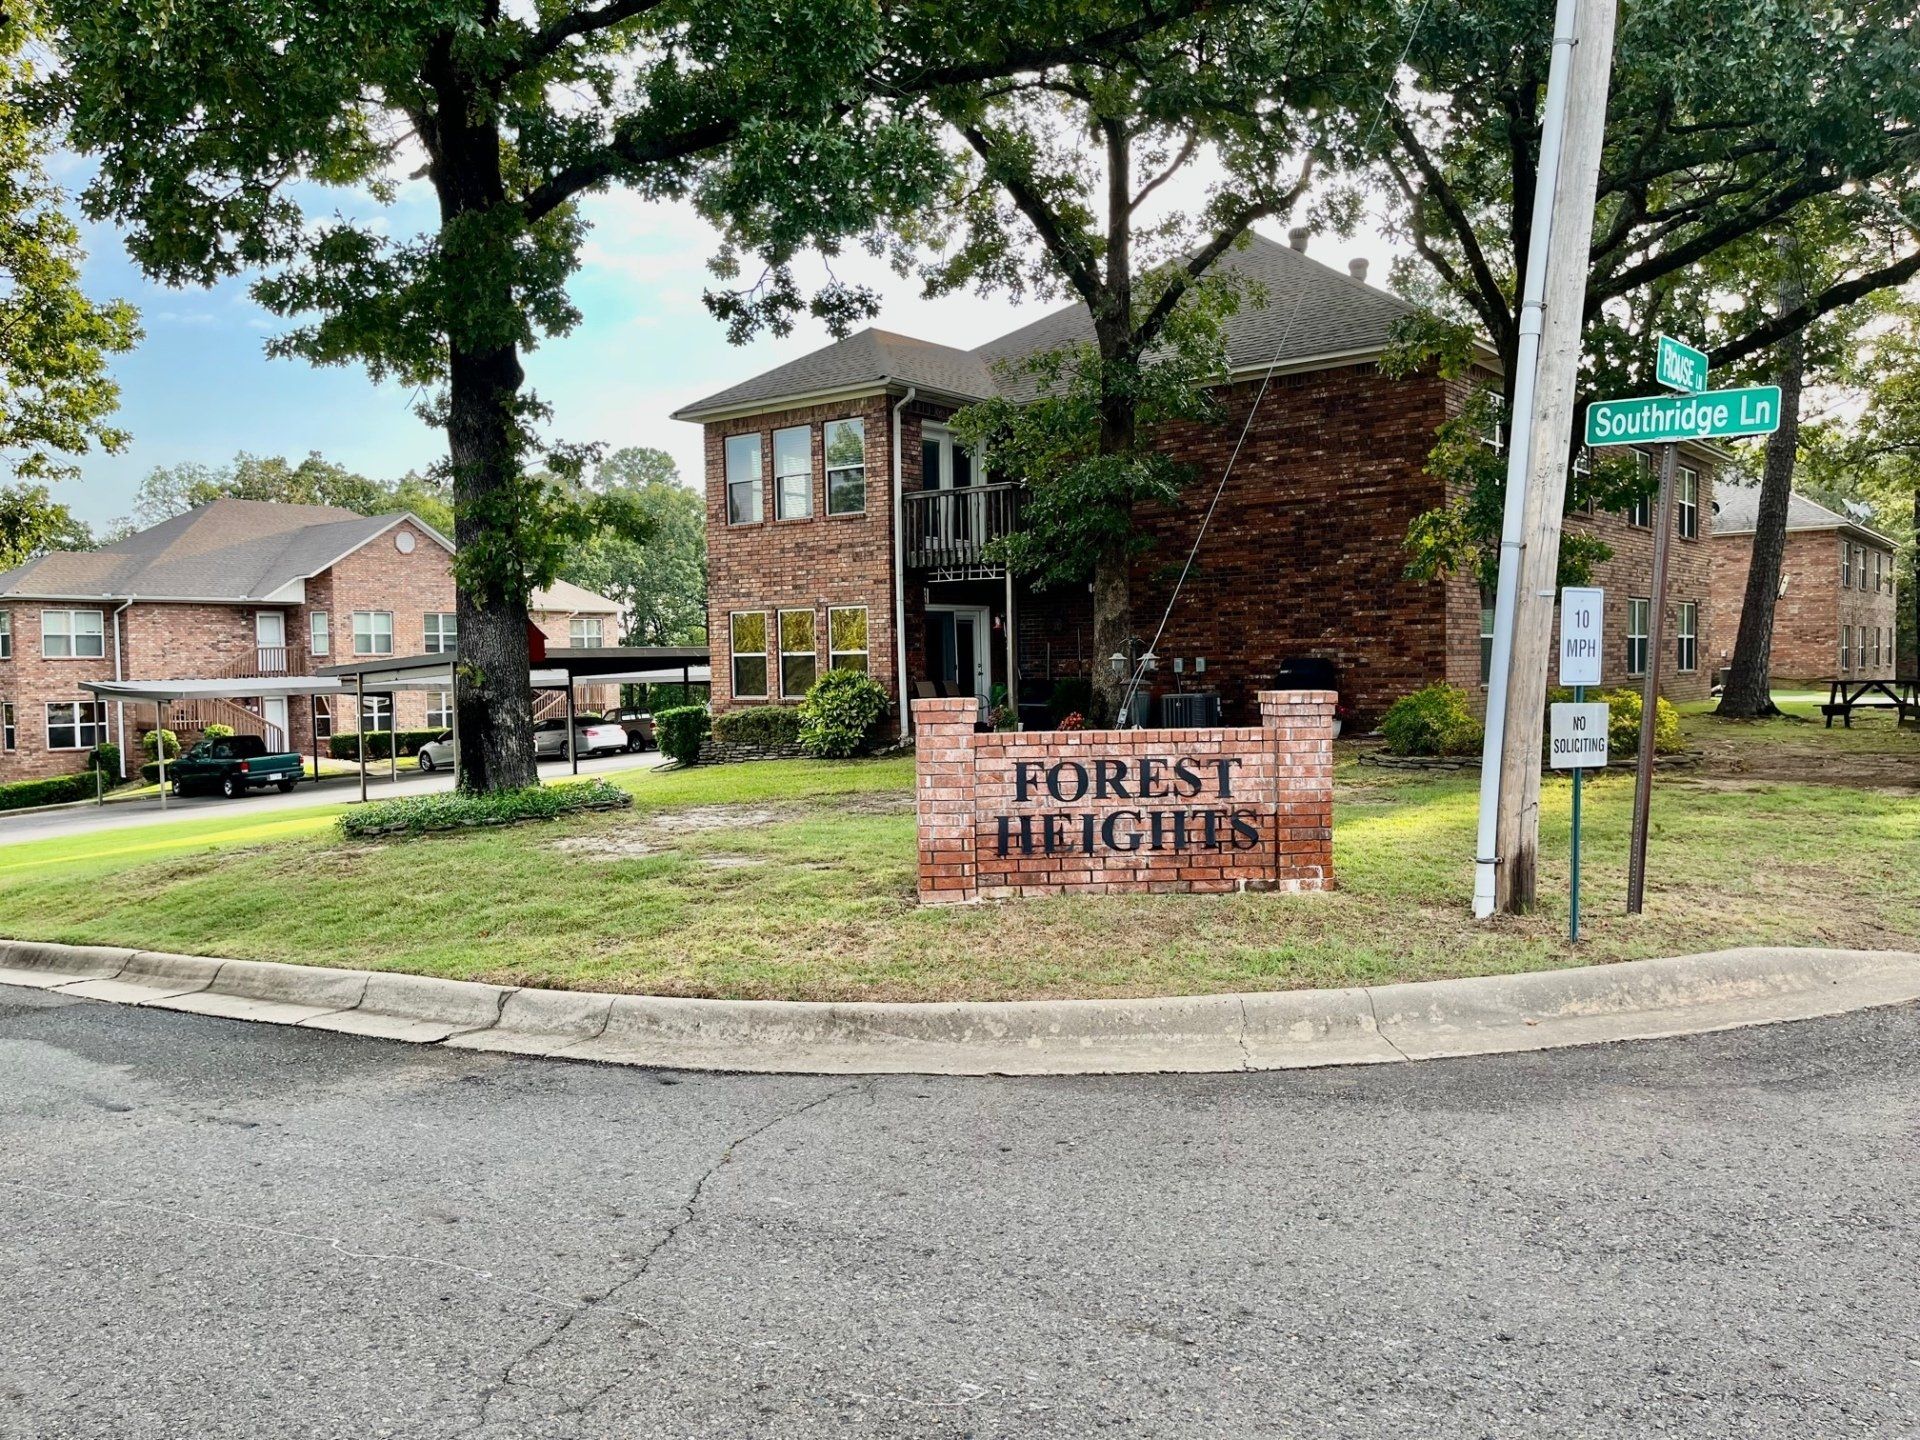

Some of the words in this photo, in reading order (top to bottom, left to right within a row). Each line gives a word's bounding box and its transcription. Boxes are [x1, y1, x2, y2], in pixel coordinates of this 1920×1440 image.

[1663, 343, 1695, 386] ROUSE
[1695, 374, 1703, 390] LN
[1595, 400, 1728, 437] Southridge
[1740, 395, 1770, 425] Ln
[1574, 609, 1590, 629] 10
[1566, 639, 1596, 658] MPH
[1572, 715, 1587, 731] NO
[1553, 737, 1605, 754] SOLICITING
[1010, 757, 1242, 802] FOREST
[994, 808, 1260, 857] HEIGHTS
